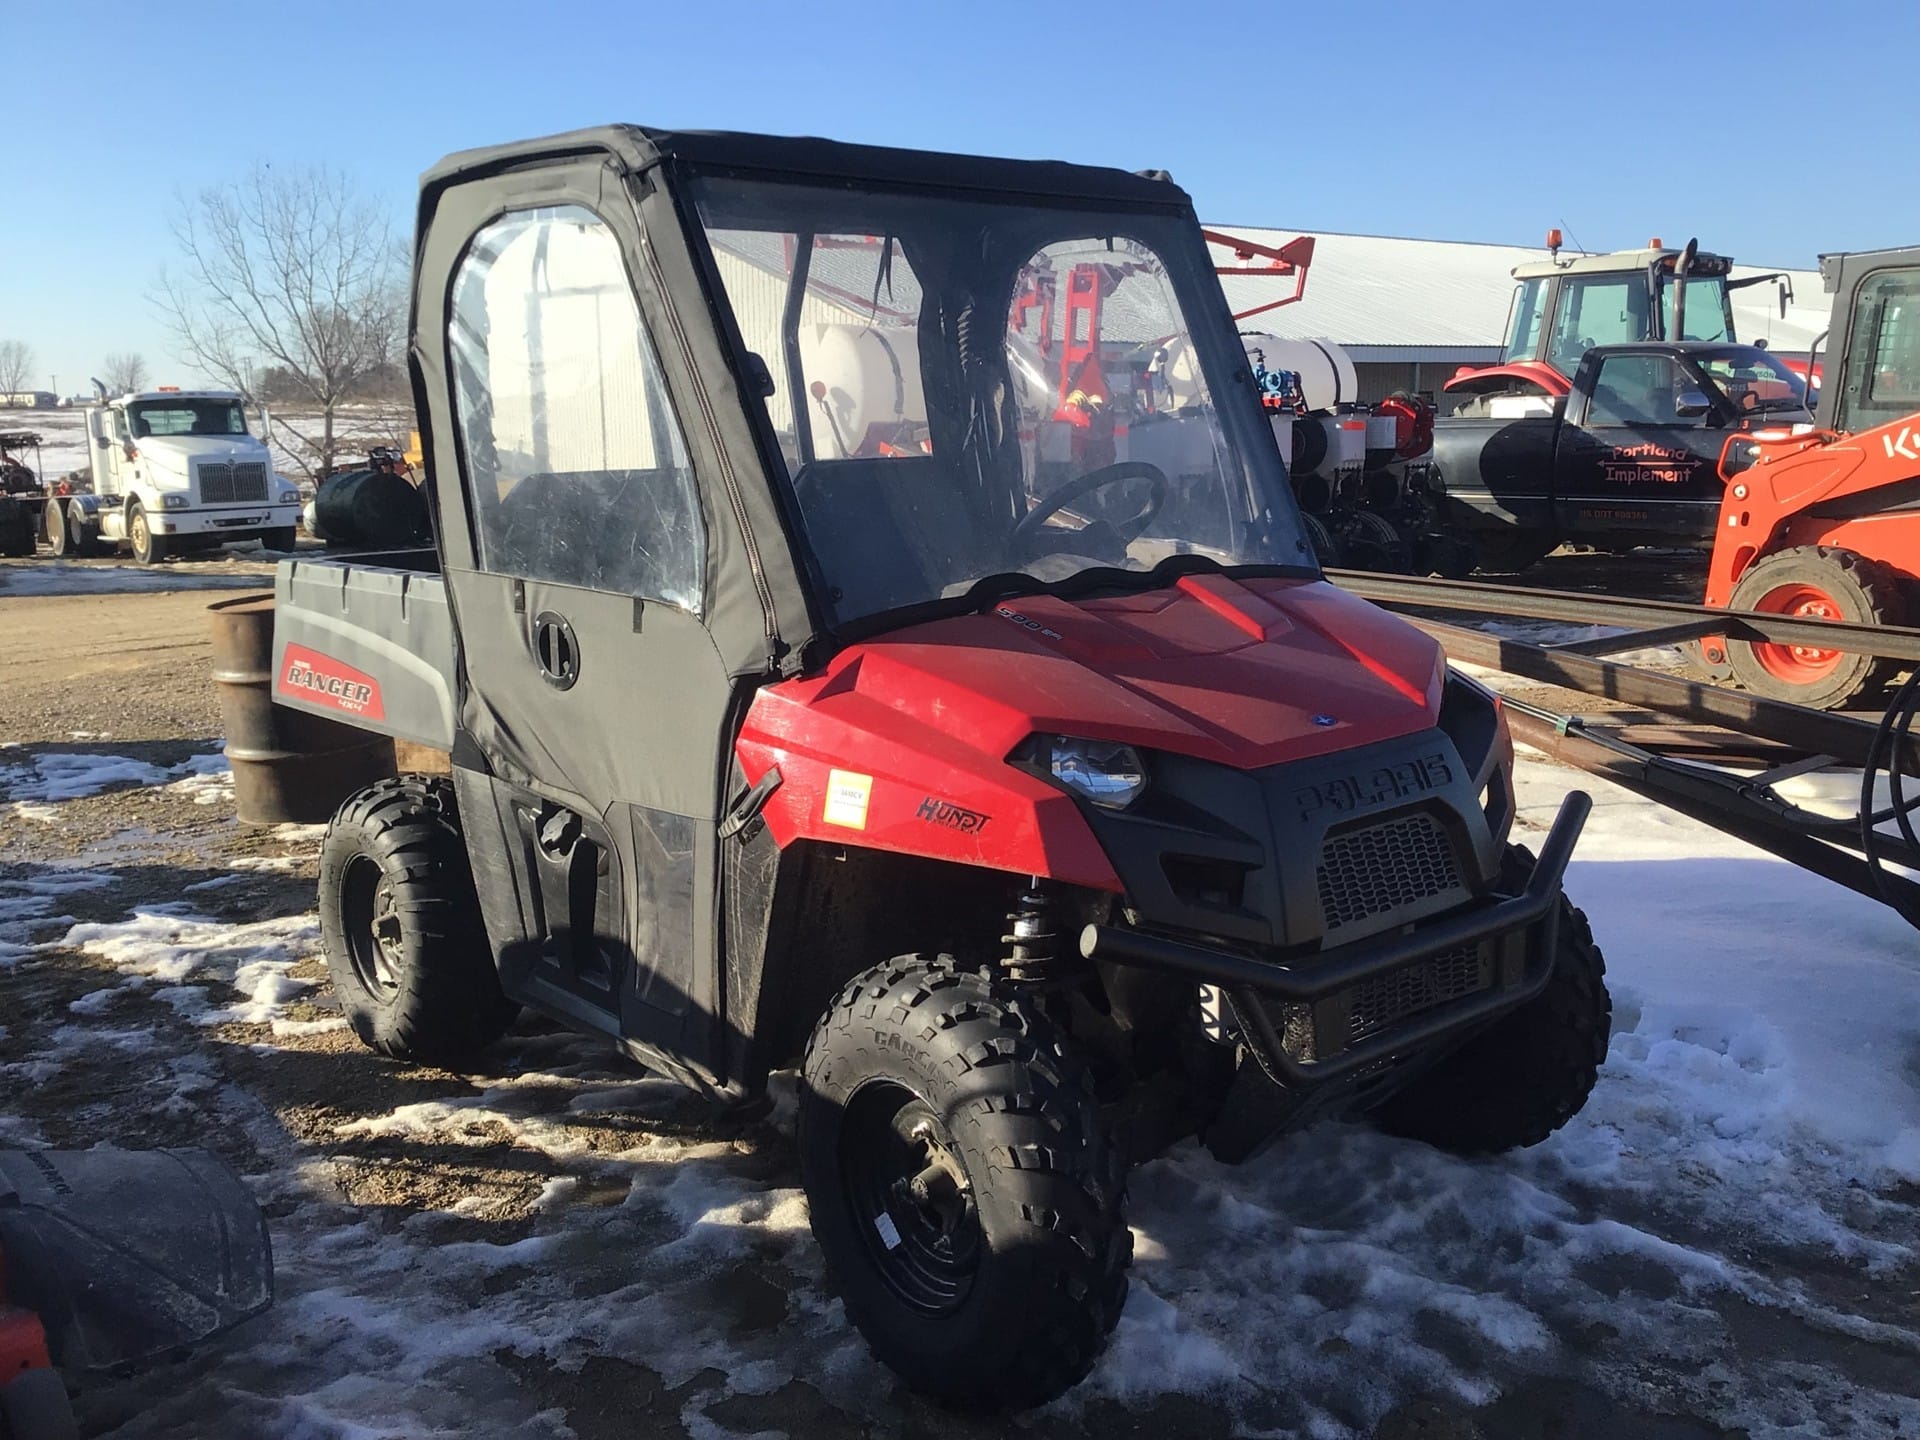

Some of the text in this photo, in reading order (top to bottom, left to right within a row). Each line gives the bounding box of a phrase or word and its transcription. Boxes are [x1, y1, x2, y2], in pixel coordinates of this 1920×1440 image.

[1611, 442, 1690, 461] Portland
[1605, 466, 1692, 486] Implement
[996, 606, 1042, 632] 500
[286, 665, 372, 705] RANGER
[1288, 753, 1453, 823] POLARIS
